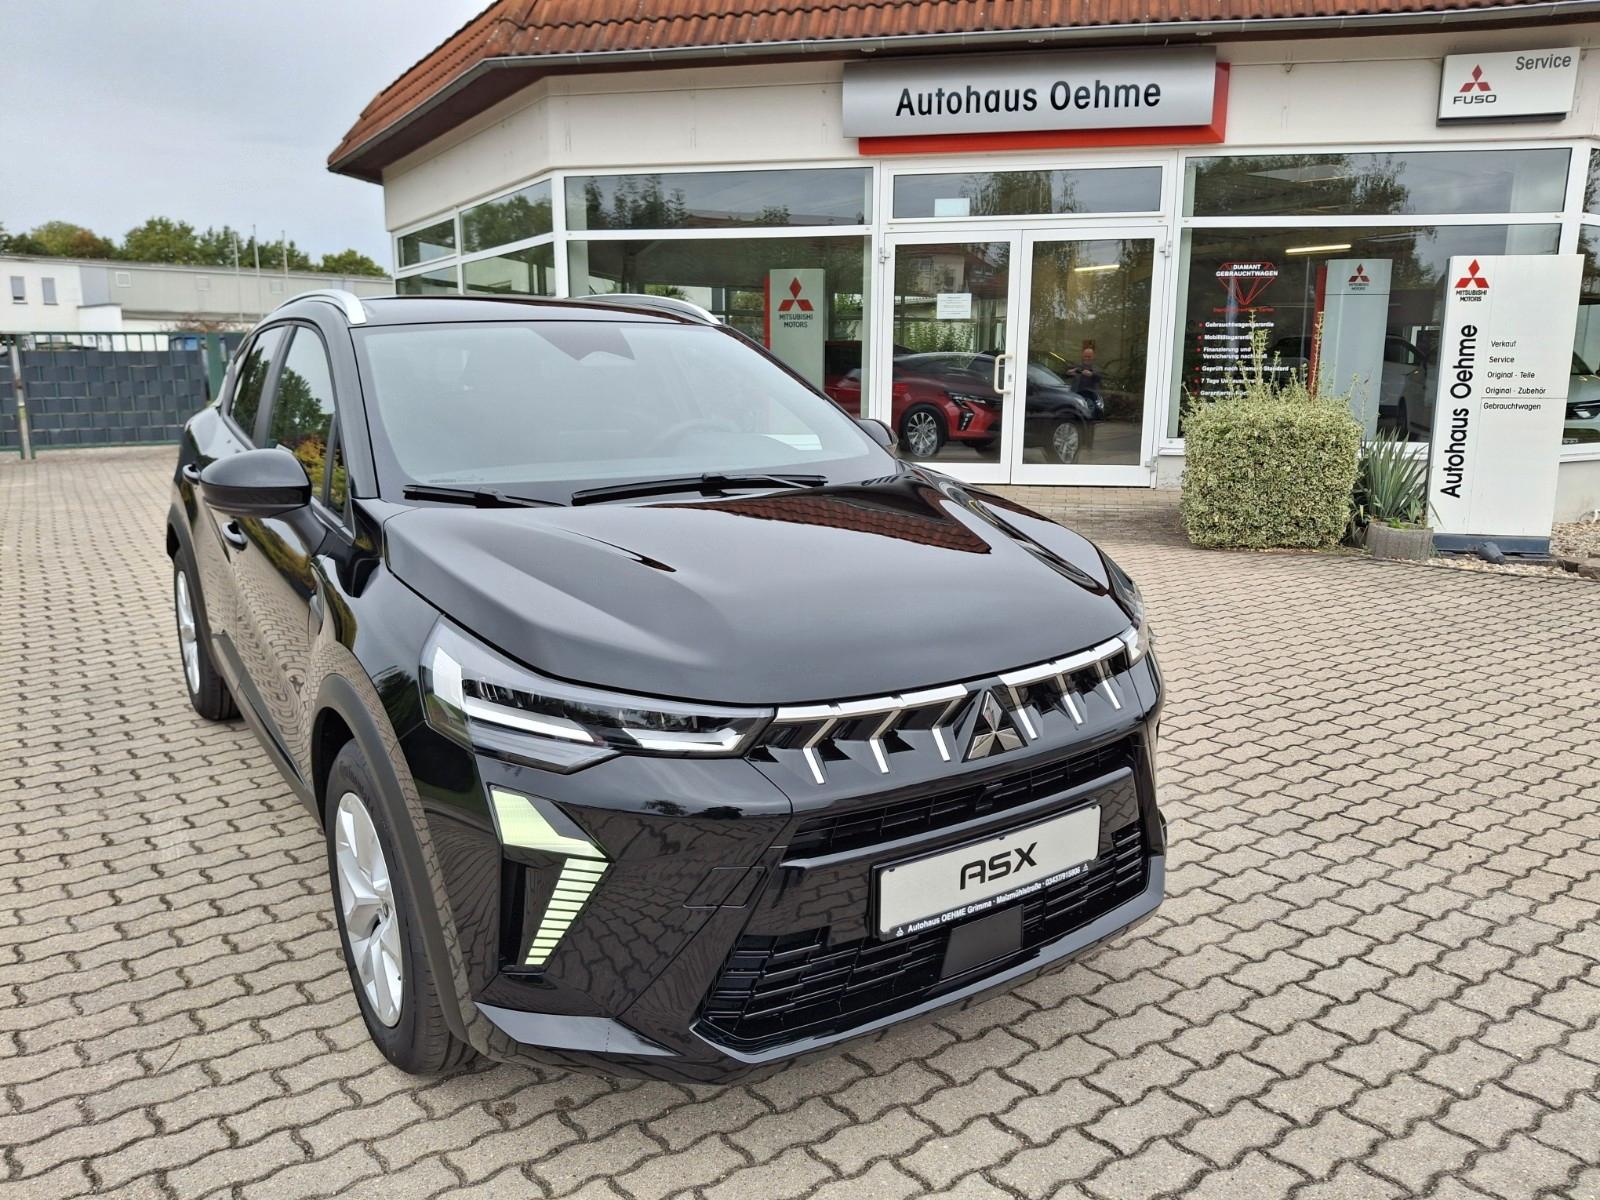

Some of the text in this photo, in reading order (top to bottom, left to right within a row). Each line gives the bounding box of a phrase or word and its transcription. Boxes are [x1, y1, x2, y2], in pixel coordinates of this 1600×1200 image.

[1515, 53, 1572, 71] Service
[895, 80, 1162, 117] Autohaus Oehme
[1452, 94, 1497, 105] FUSO
[778, 313, 814, 321] MITSUBISHI
[783, 321, 808, 329] MOTORS
[1490, 340, 1517, 348] Verkauf
[1487, 371, 1514, 380] Original
[1485, 387, 1512, 396] Original
[1518, 386, 1547, 395] Zubehör
[1440, 324, 1478, 499] Autohaus Oehme
[1483, 402, 1541, 411] Gebrauchtwagen
[960, 842, 1038, 890] ASX
[907, 917, 941, 933] Autohaus
[941, 907, 967, 922] OEHME
[967, 900, 993, 914] Grimma
